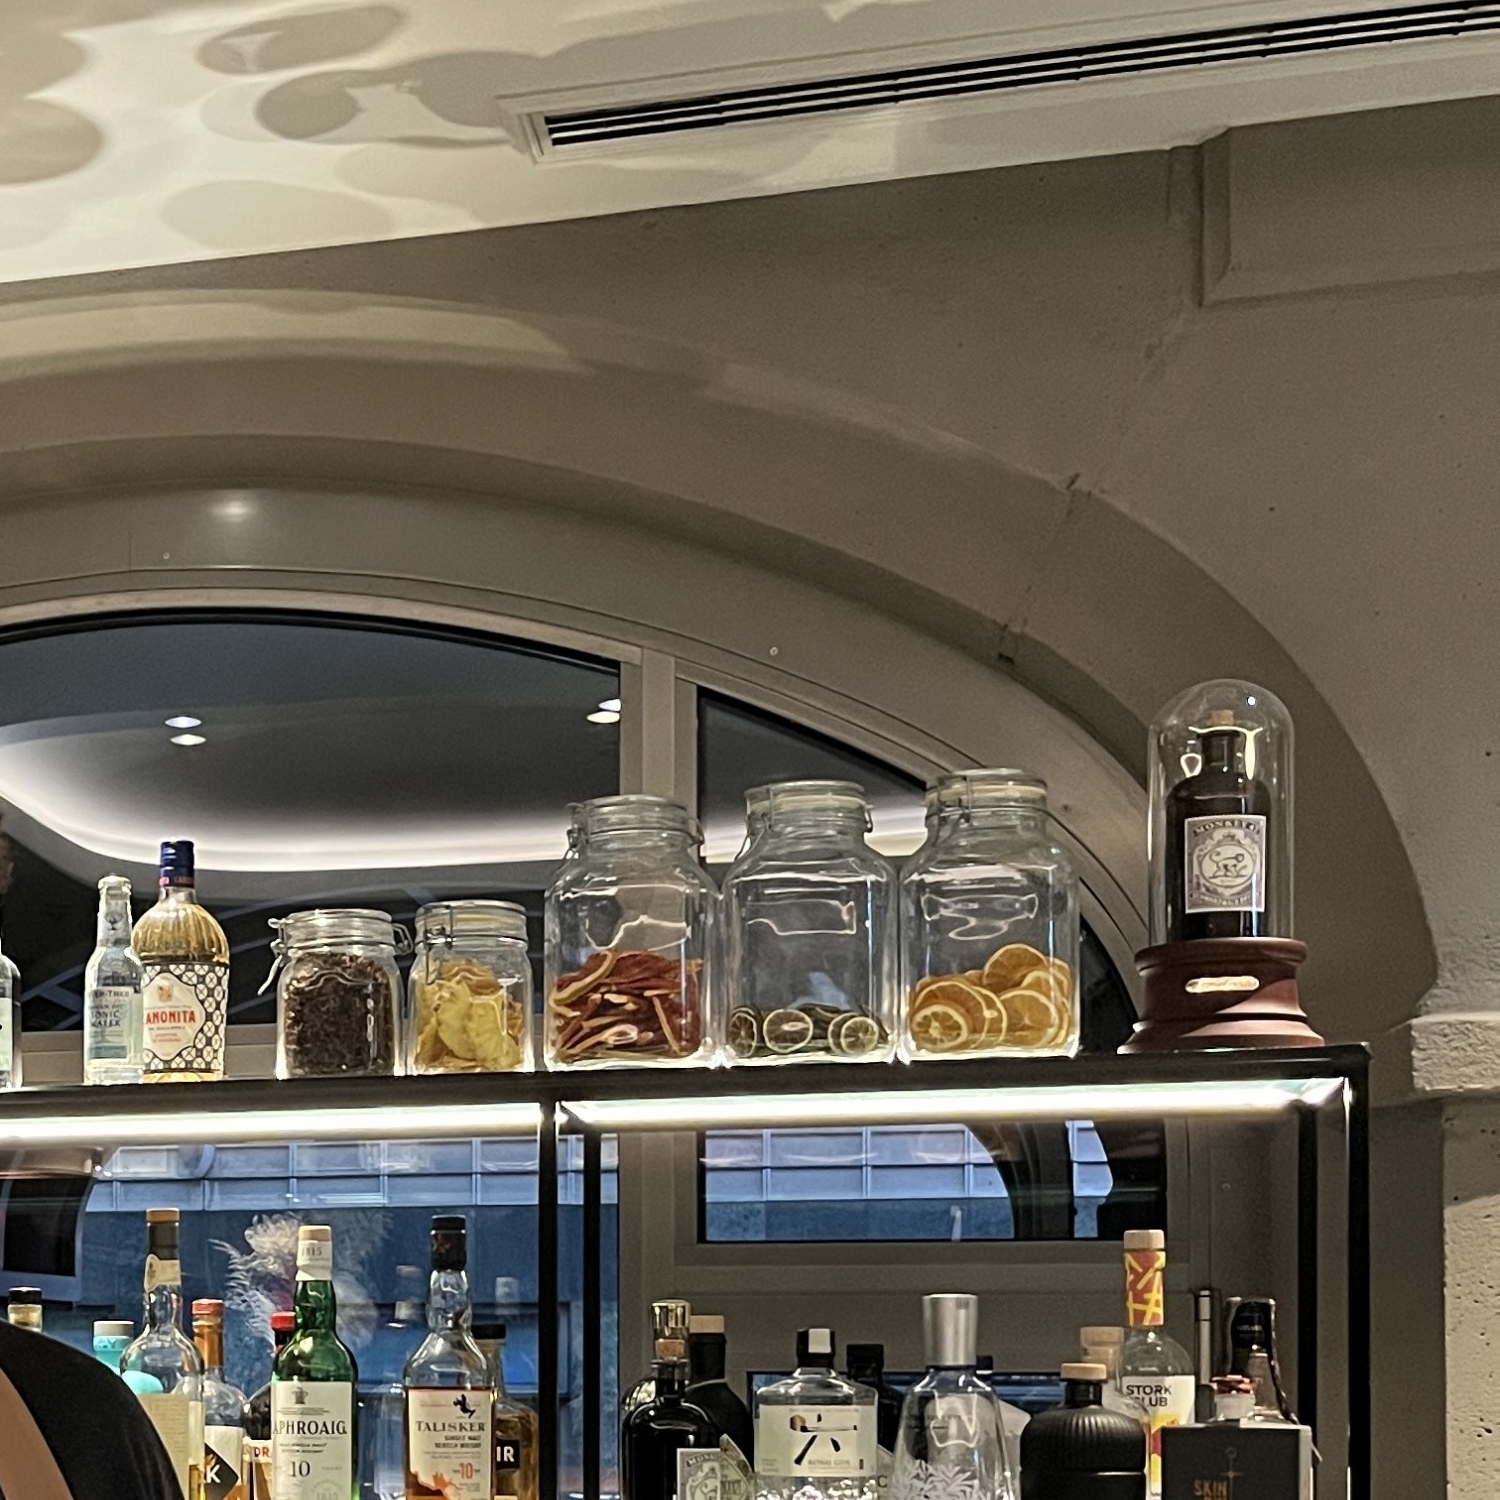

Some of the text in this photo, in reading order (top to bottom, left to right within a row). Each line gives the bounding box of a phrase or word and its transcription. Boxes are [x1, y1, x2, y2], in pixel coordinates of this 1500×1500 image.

[146, 1010, 196, 1025] ANONITA
[1126, 1384, 1173, 1396] STORK
[273, 1420, 348, 1436] APHROAIG
[416, 1420, 486, 1433] TALISKER
[793, 1413, 858, 1467] 六
[496, 1445, 515, 1463] IR
[206, 1464, 221, 1484] K
[290, 1460, 311, 1478] 10
[459, 1462, 474, 1480] 10
[1193, 1479, 1228, 1497] SKIN
